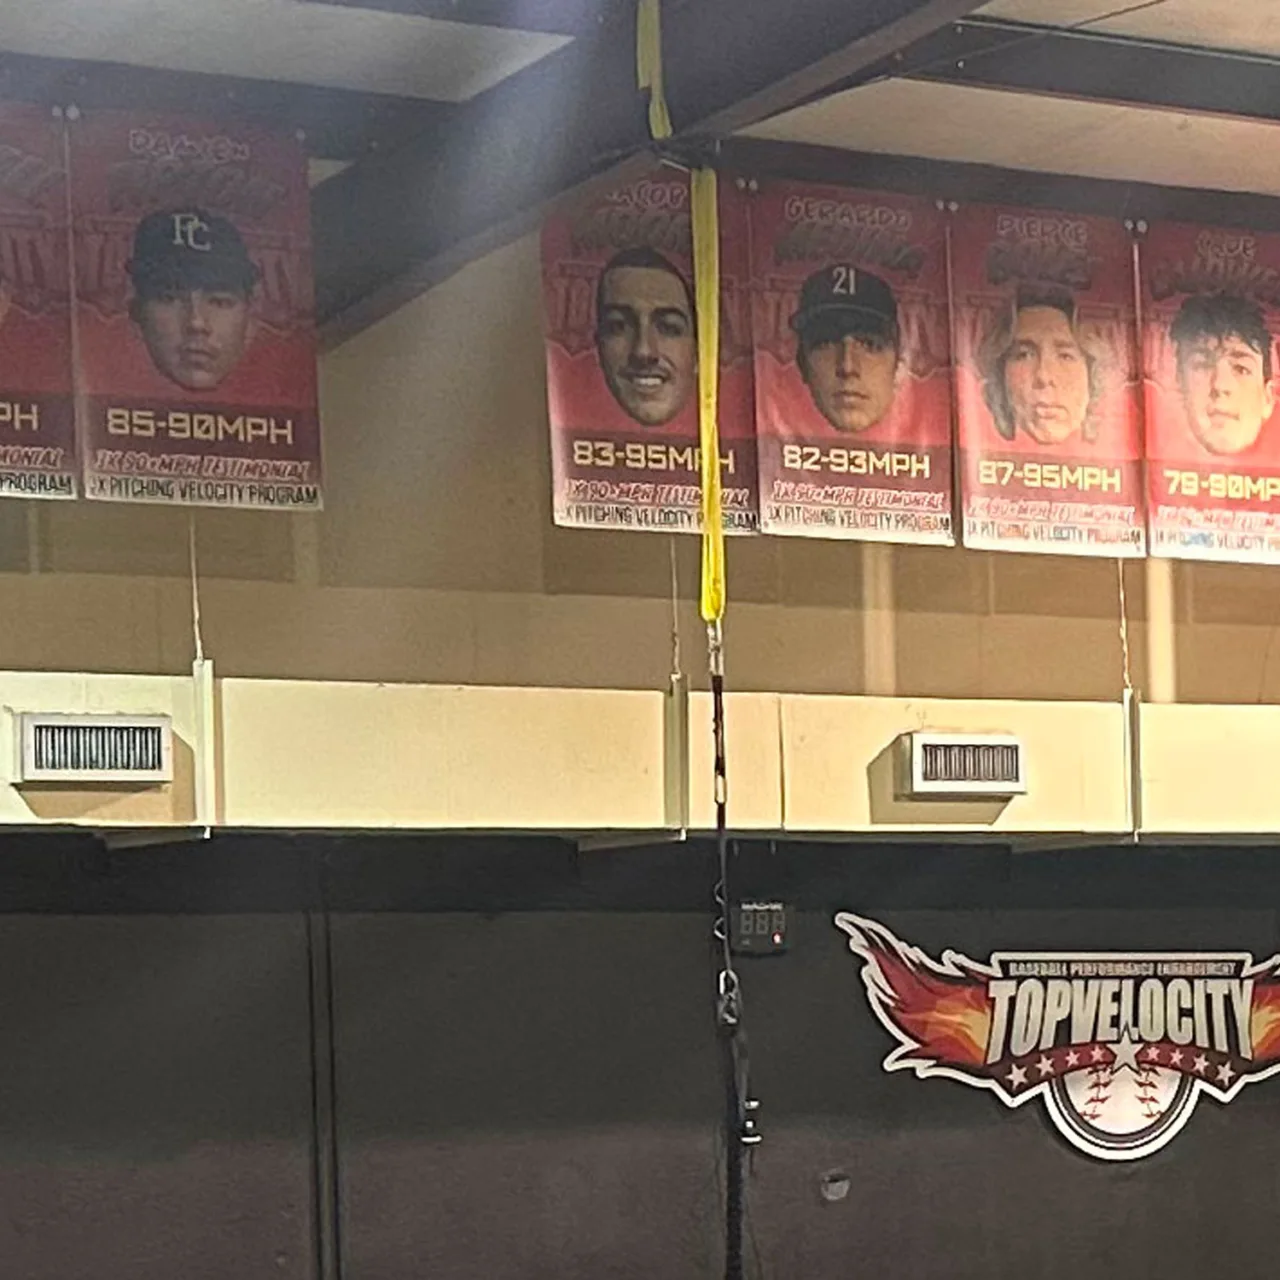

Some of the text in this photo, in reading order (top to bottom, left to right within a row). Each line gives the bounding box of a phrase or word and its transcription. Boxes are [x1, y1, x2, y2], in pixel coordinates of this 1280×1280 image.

[832, 265, 857, 296] 21
[107, 407, 294, 445] 85-90MPH
[573, 440, 736, 475] 83-95MH
[783, 444, 931, 479] 82-93MPH
[110, 476, 175, 498] PITCHING
[178, 479, 244, 501] VELOCITY
[247, 483, 319, 504] PROGRAM
[979, 460, 1122, 494] 87-95MPH
[575, 503, 633, 525] PITCHING
[986, 977, 1254, 1065] TOPVELOCITY
